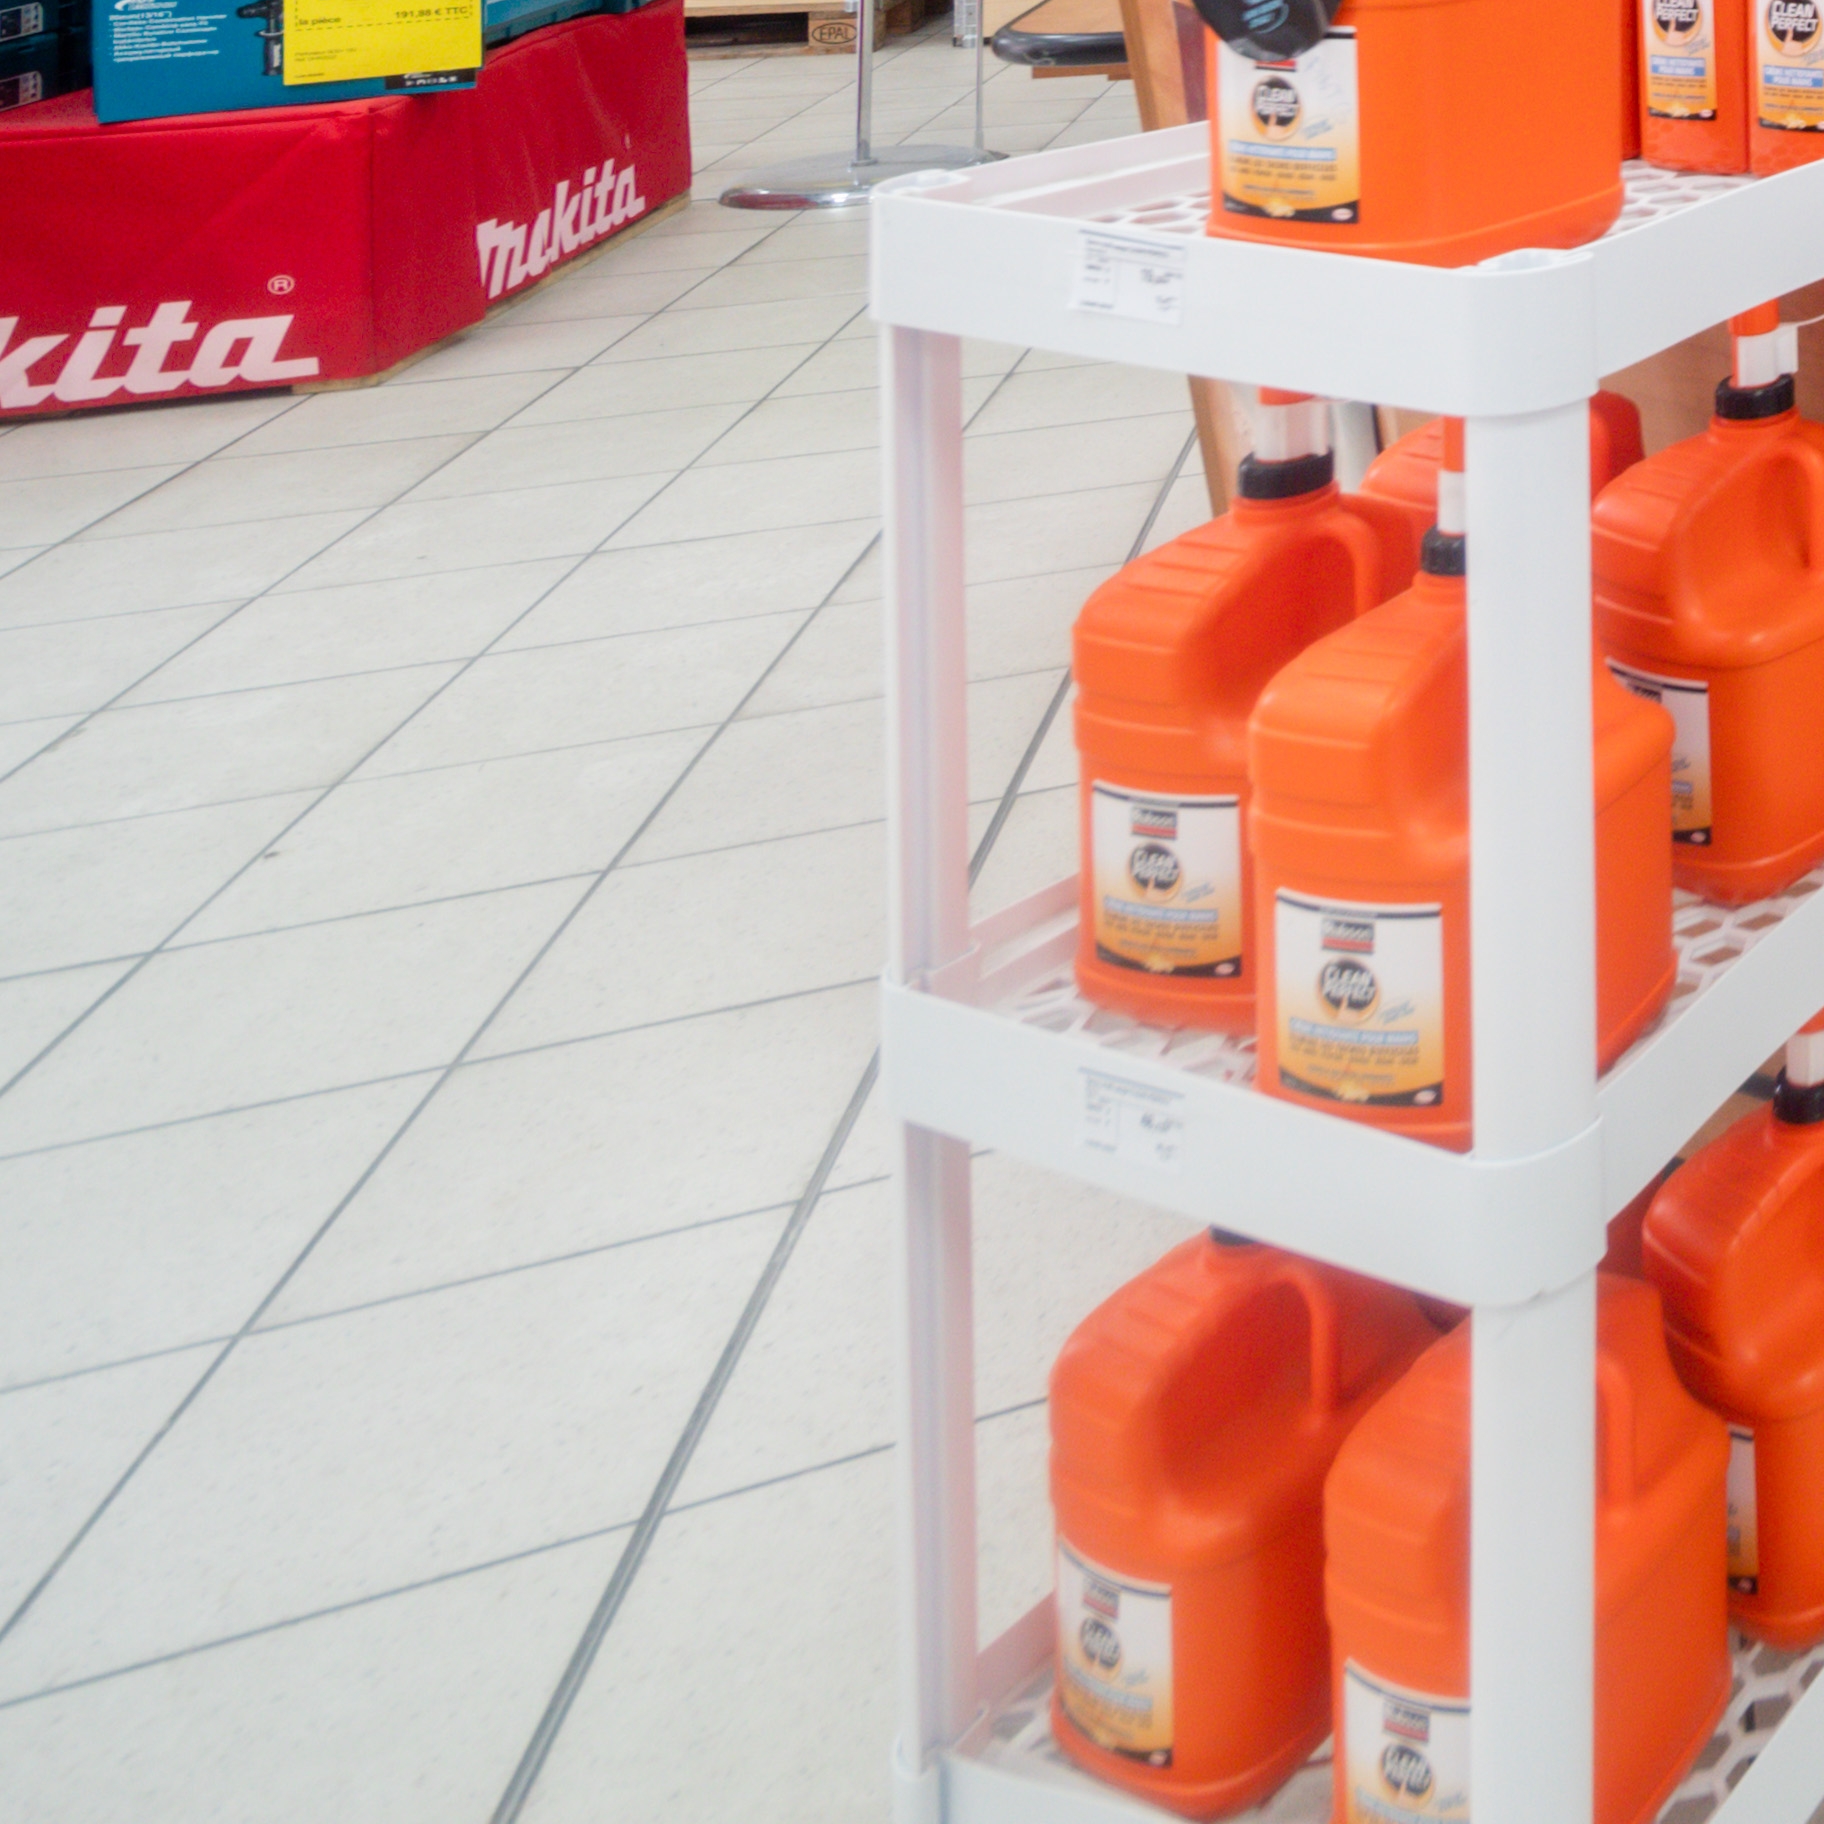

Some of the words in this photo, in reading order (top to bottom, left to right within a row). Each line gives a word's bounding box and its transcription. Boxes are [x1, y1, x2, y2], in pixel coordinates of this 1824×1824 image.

[444, 7, 468, 16] TTC
[1771, 0, 1815, 18] CLEAN
[1770, 16, 1821, 32] PERFECT
[0, 301, 319, 409] kita
